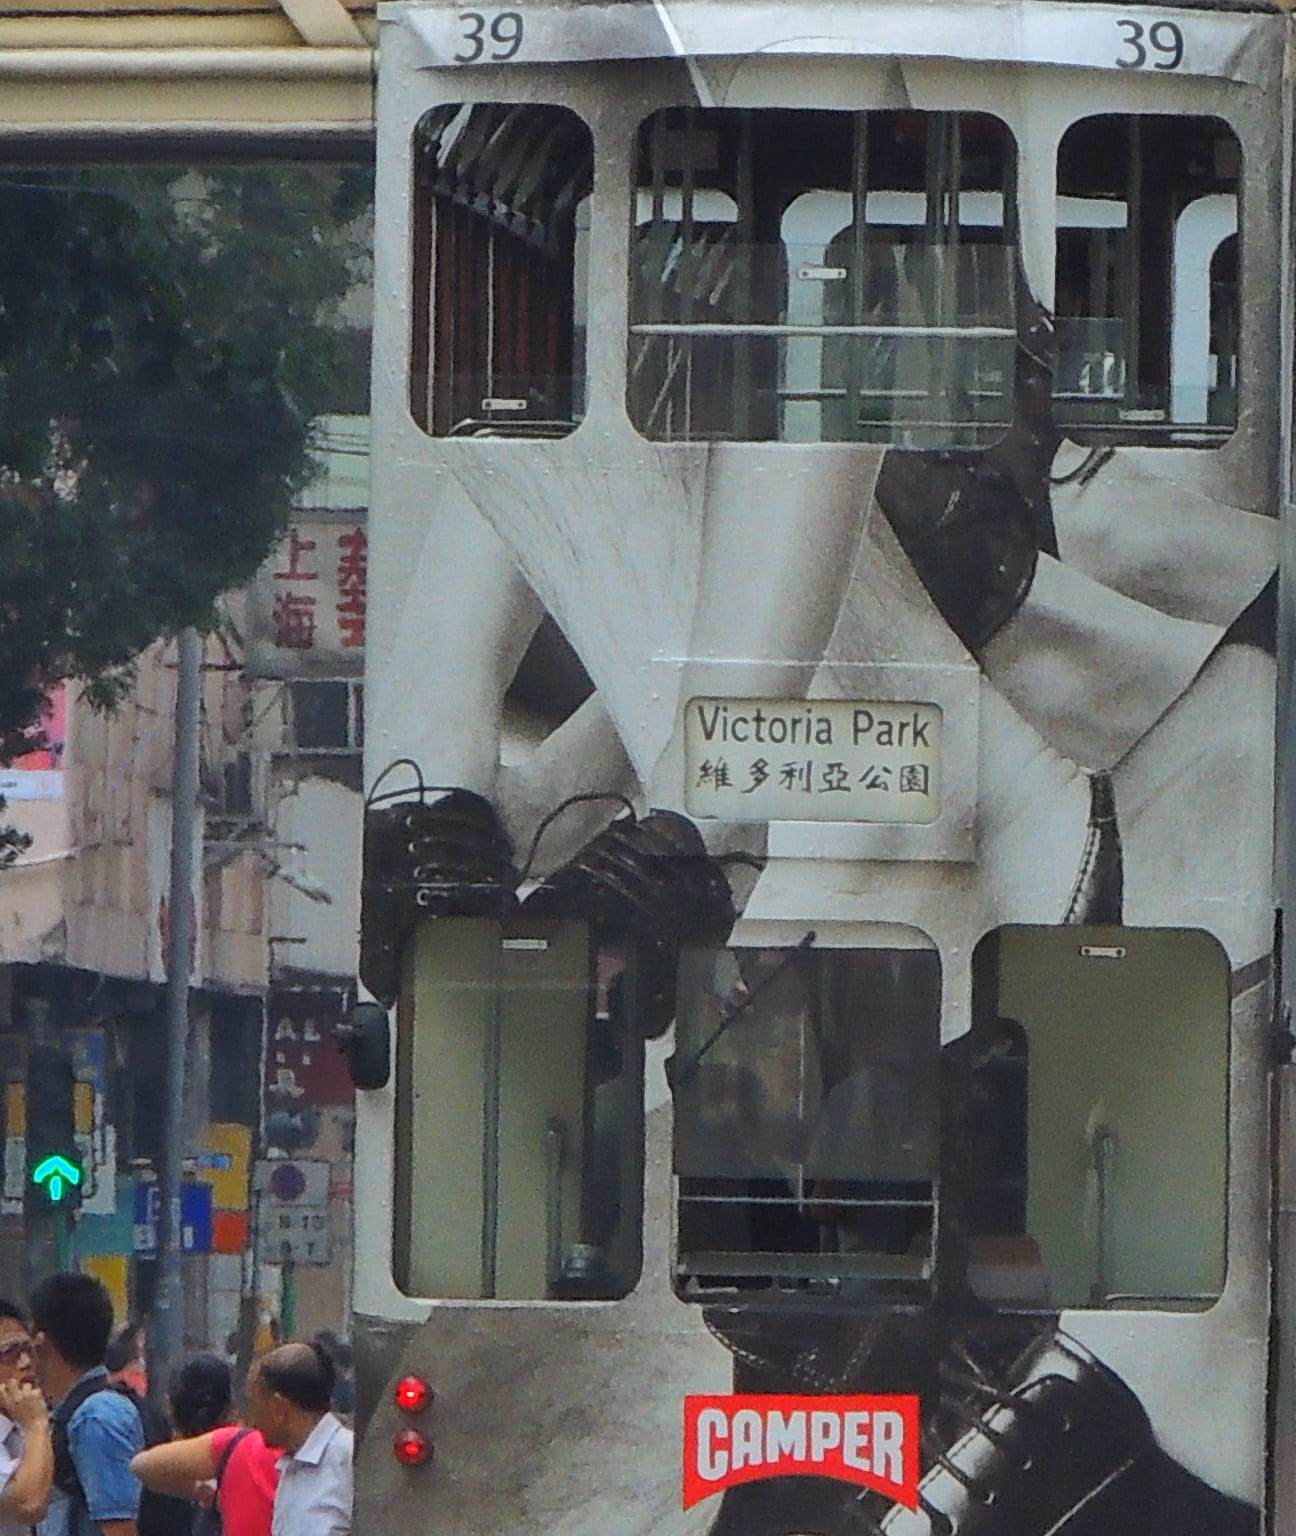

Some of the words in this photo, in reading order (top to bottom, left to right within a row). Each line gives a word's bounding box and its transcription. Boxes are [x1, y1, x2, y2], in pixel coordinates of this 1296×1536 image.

[454, 12, 523, 62] 39
[1115, 20, 1183, 70] 39
[698, 705, 833, 745] Victoria
[852, 710, 930, 748] Park
[696, 756, 929, 797] 維多利亞公園
[697, 1408, 904, 1486] CAMPER
